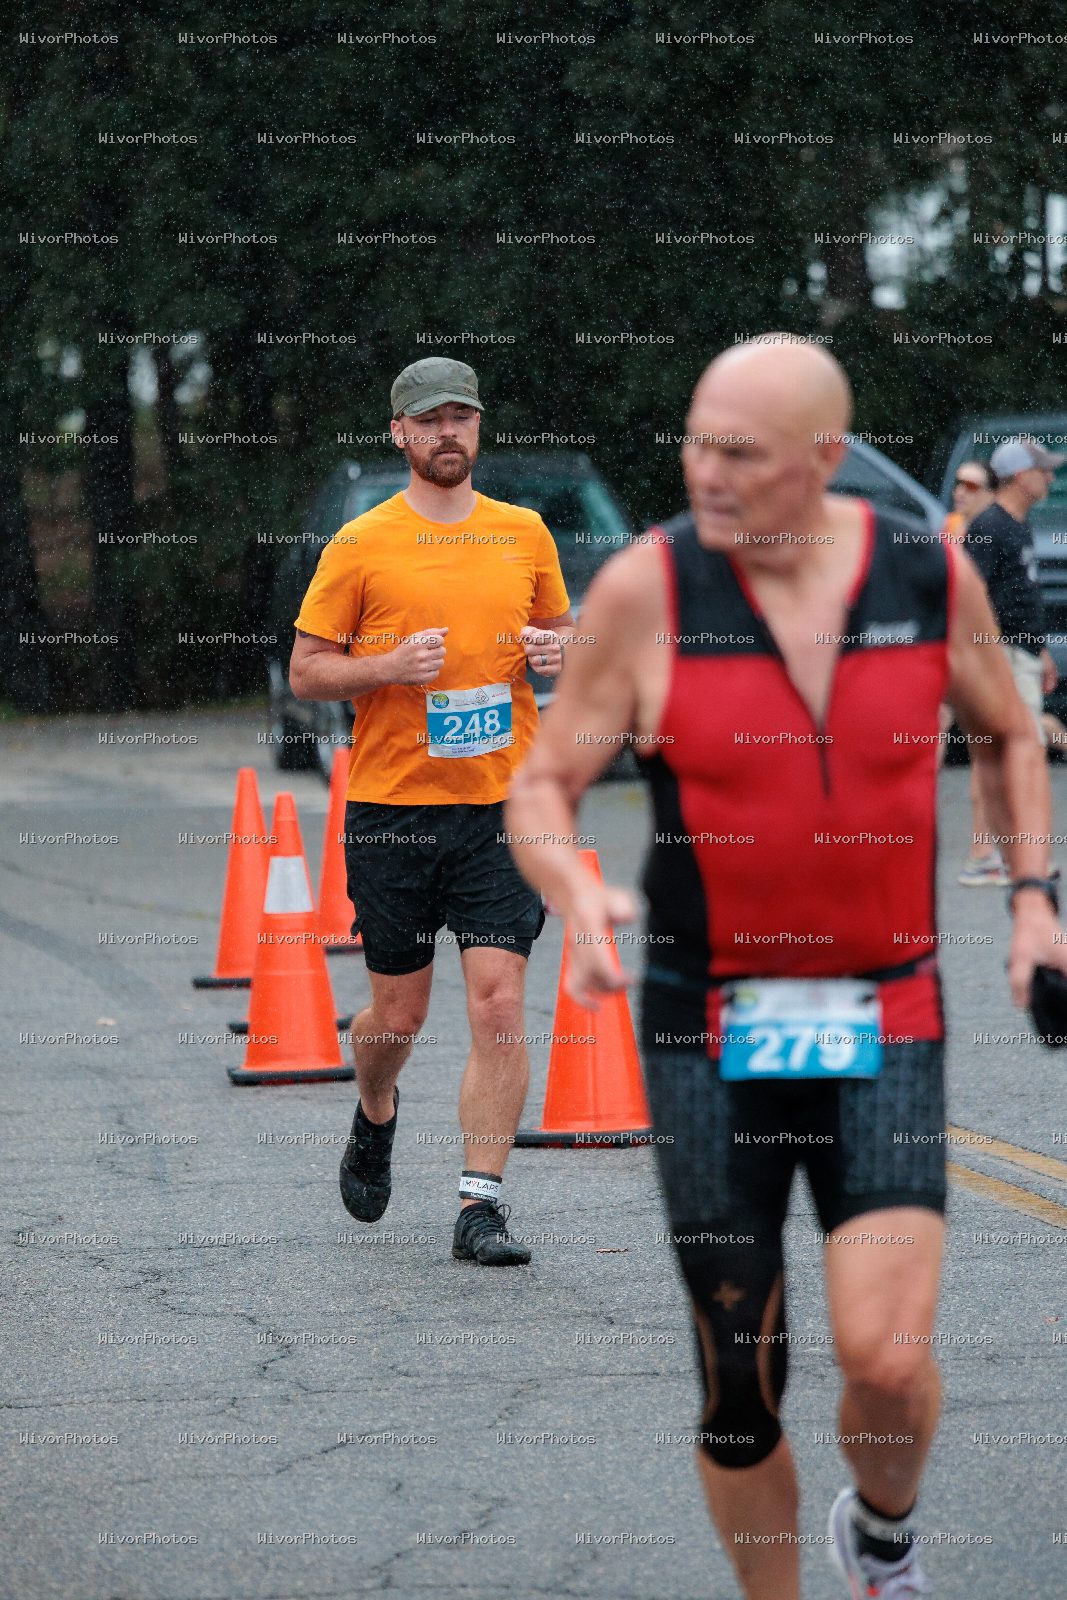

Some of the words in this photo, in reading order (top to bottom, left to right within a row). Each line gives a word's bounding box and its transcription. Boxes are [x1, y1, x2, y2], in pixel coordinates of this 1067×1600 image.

[443, 709, 501, 744] 248
[747, 1026, 856, 1072] 279
[465, 1180, 499, 1193] MYLAPS
